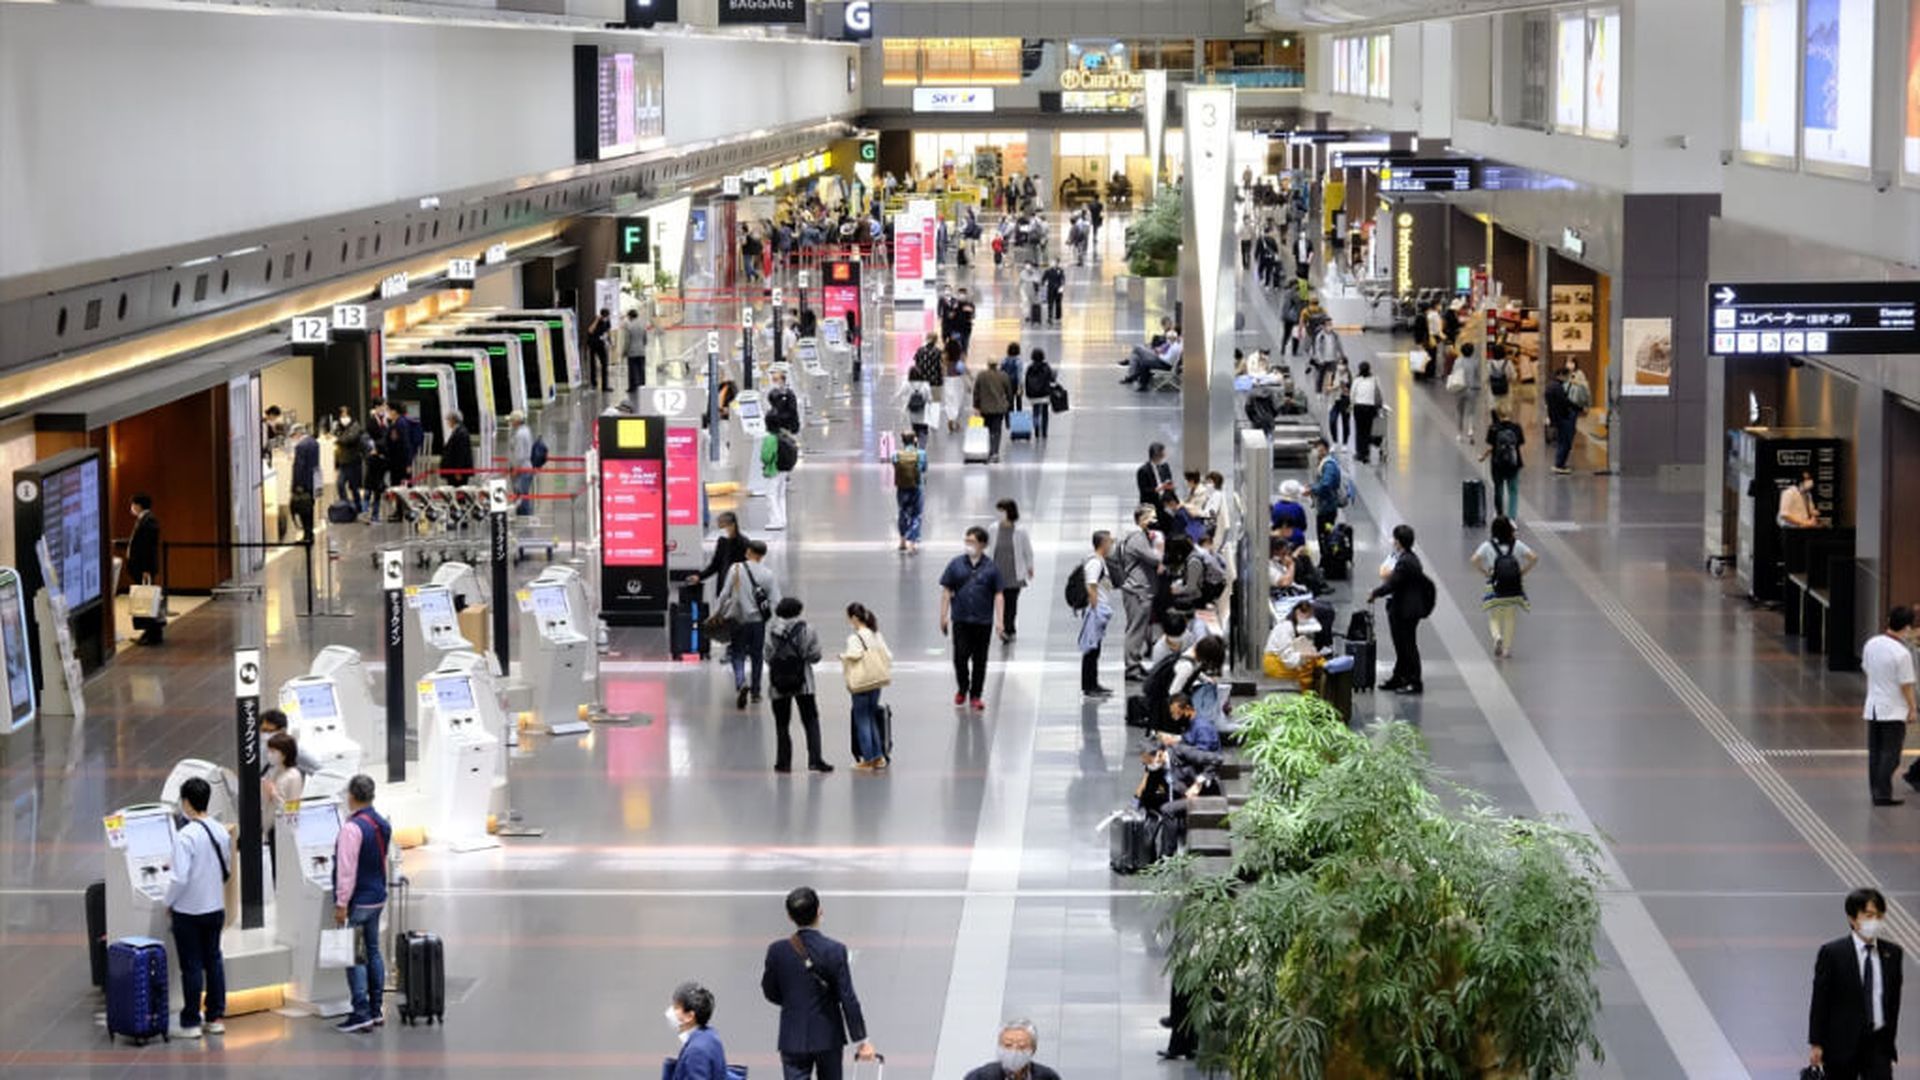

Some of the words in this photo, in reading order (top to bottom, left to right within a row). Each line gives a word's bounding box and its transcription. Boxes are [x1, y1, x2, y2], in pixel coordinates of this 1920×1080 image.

[729, 0, 794, 10] BAGGAGE
[845, 1, 871, 30] G
[1202, 103, 1217, 128] 3
[862, 143, 875, 159] G
[625, 226, 641, 254] F
[340, 307, 361, 326] 13
[299, 319, 323, 339] 12
[660, 391, 682, 411] 12
[243, 700, 257, 765] チェックイン
